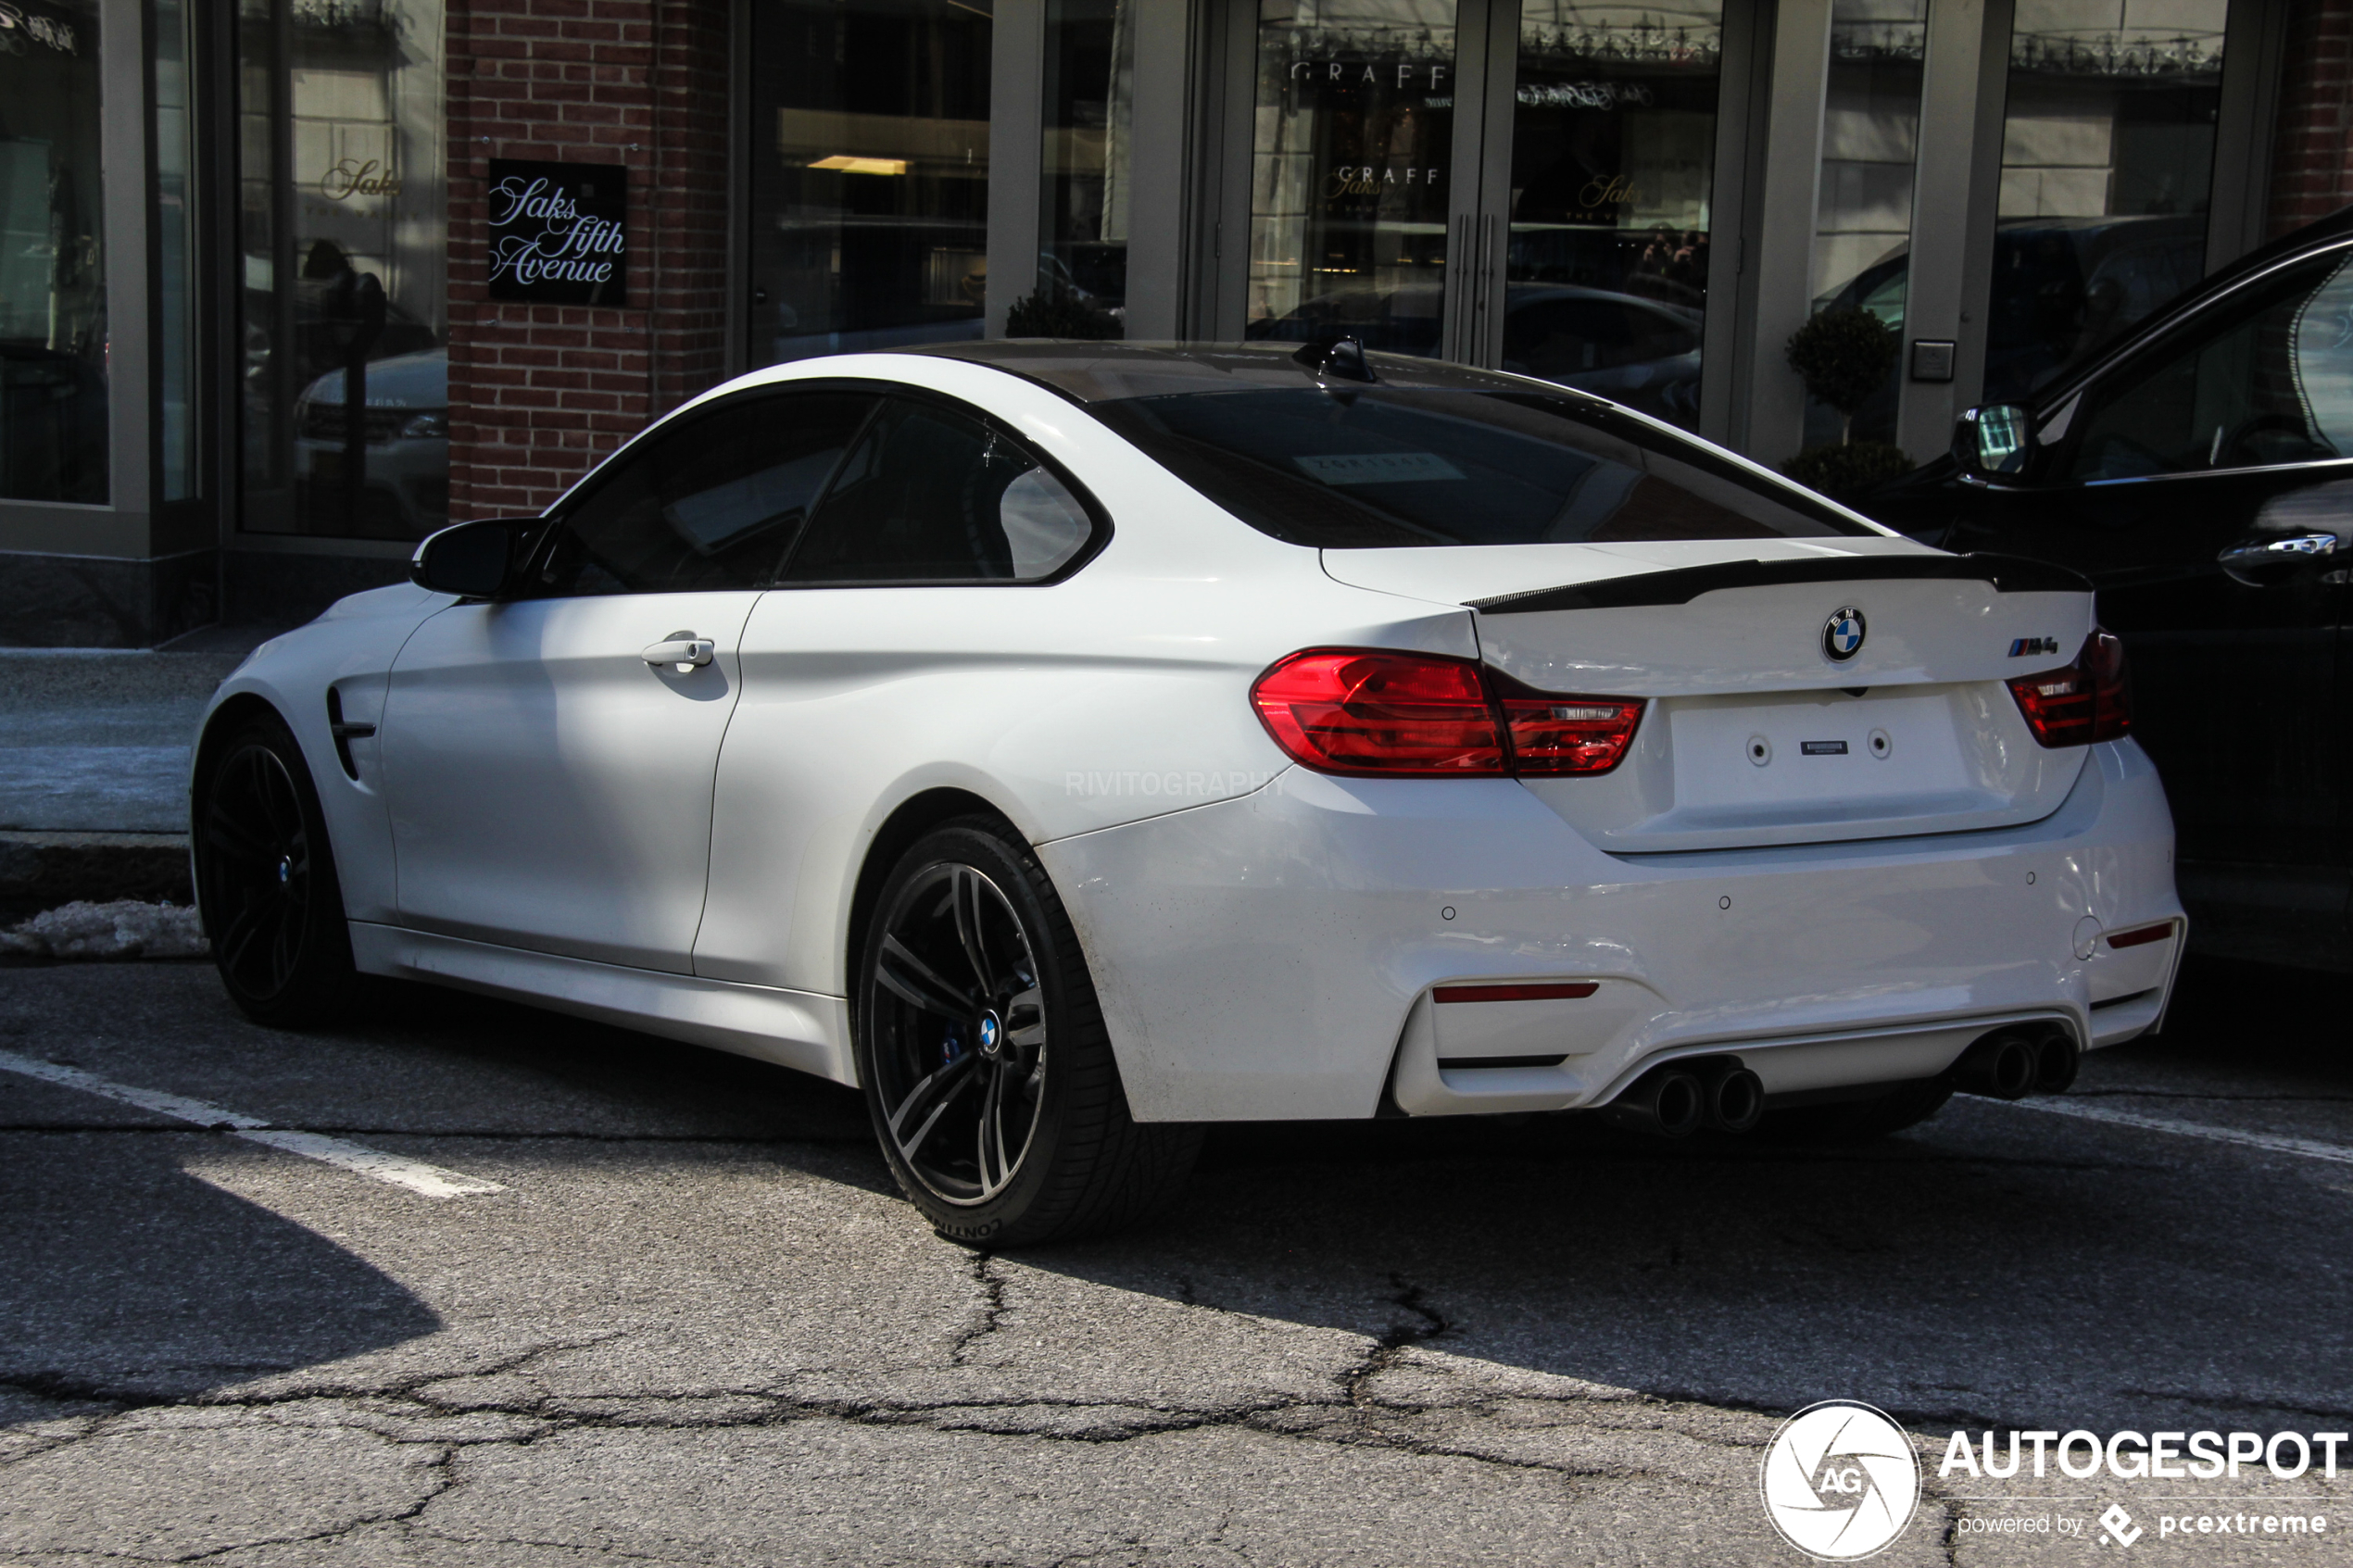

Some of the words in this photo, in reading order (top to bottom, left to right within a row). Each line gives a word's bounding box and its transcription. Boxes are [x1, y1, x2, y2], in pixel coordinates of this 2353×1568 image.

[1290, 61, 1445, 90] GRAFF
[321, 158, 402, 201] Saks
[1320, 167, 1382, 199] Saks
[1340, 166, 1438, 184] GRAFF
[489, 177, 576, 226] Saks
[489, 235, 613, 285] Avenue
